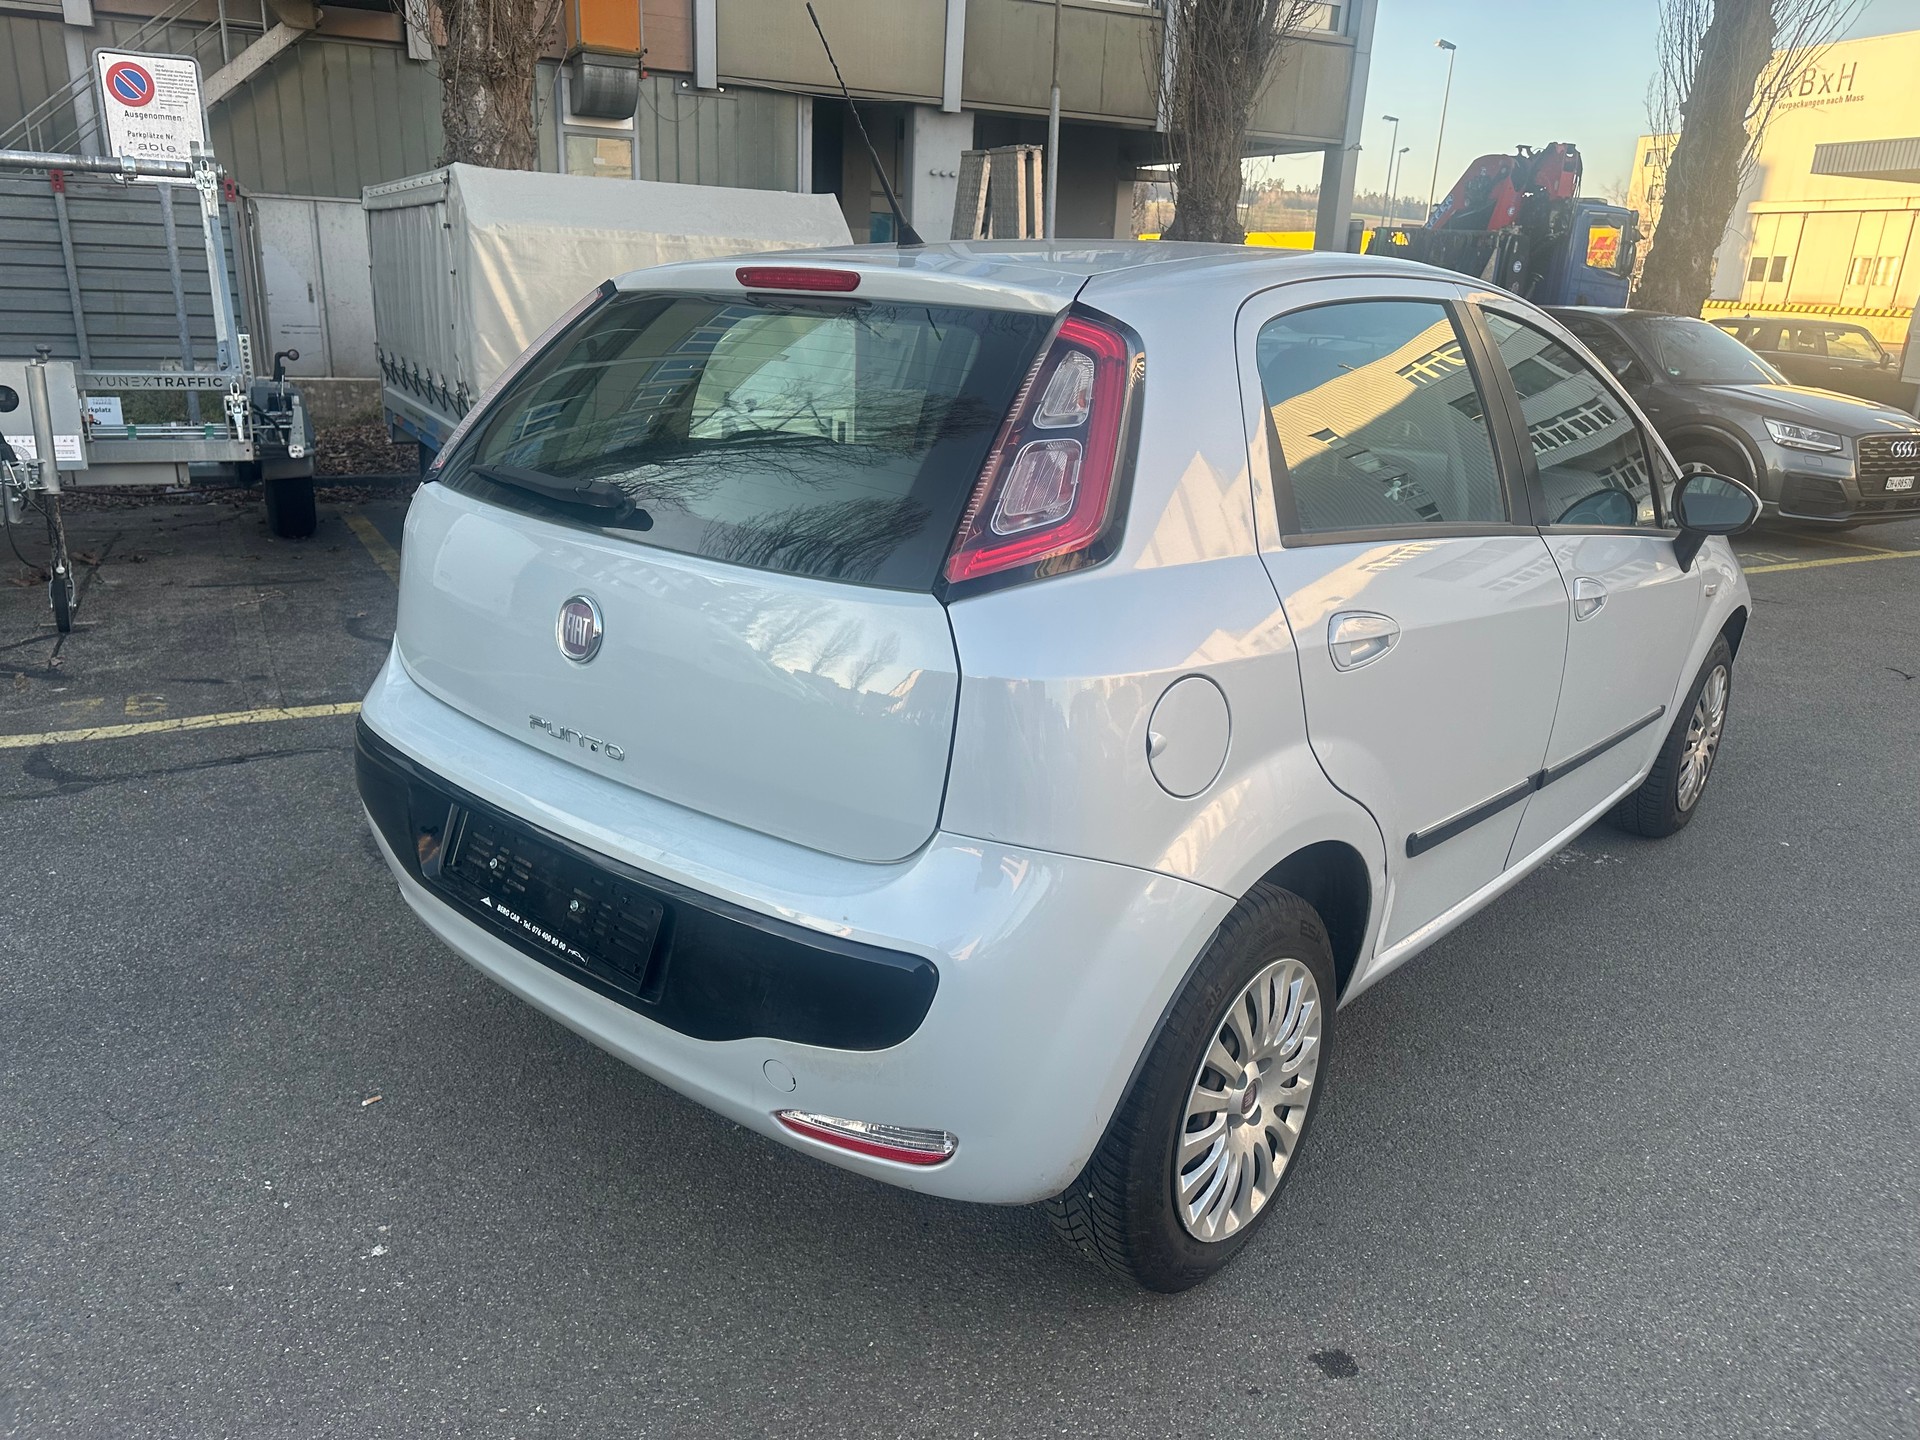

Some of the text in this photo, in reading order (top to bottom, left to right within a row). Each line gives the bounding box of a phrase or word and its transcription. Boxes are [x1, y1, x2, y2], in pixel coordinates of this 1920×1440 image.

[1778, 94, 1865, 110] Verpackungen nach Mass
[127, 130, 164, 140] Parkplätze
[565, 612, 591, 647] FIAT
[528, 714, 625, 762] PUNTO
[509, 912, 520, 924] CAR
[531, 925, 541, 936] 076
[541, 931, 552, 942] 400
